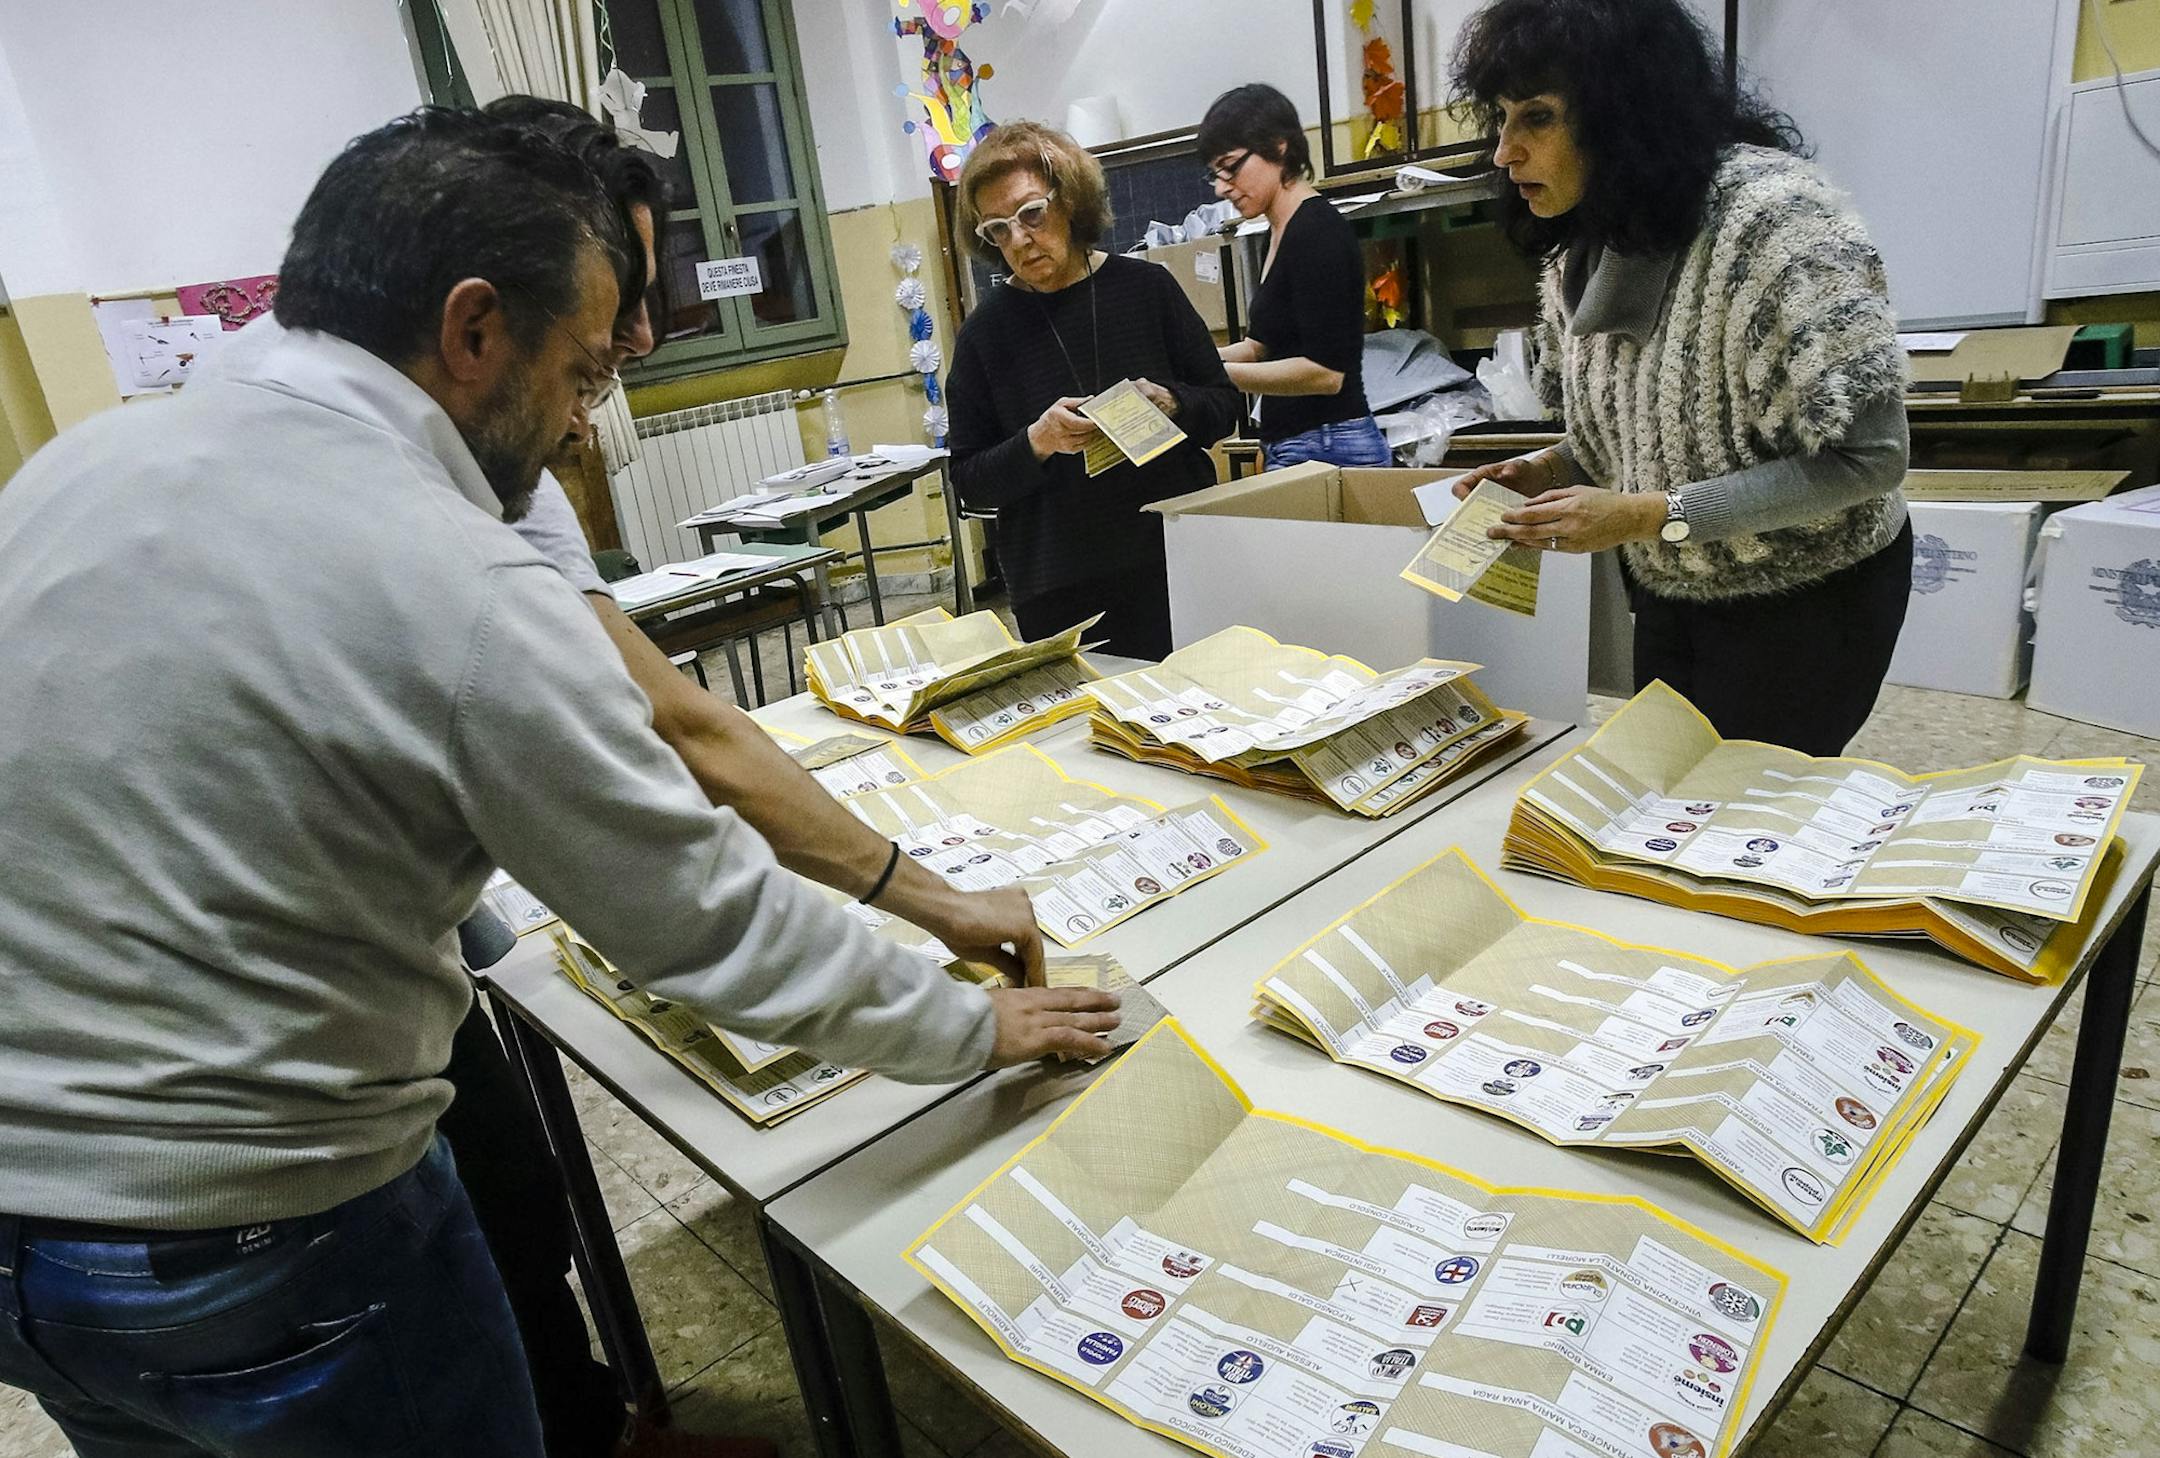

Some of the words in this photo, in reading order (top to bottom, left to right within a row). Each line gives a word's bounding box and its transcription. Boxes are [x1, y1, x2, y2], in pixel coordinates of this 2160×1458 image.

[1348, 1202, 1388, 1219] CONSOLO
[1388, 1215, 1425, 1233] CLAUDIO
[1065, 1218, 1101, 1253] CAPORALE
[1323, 1247, 1362, 1265] INTORCIA
[1361, 1259, 1386, 1274] LUIGI
[1544, 1250, 1587, 1263] MORELLI
[1027, 1261, 1050, 1282] LAURI
[1588, 1254, 1642, 1284] DONATELLA
[1047, 1281, 1071, 1306] LAURA
[1287, 1291, 1314, 1306] GALDI
[1641, 1279, 1702, 1317] VINCENZINA
[976, 1300, 1009, 1334] ADINOLFI
[1314, 1300, 1354, 1322] ALFONSO
[1543, 1311, 1584, 1336] PD
[1006, 1329, 1031, 1353] MARIO
[1084, 1336, 1119, 1356] FAMIGLIA
[1245, 1334, 1283, 1353] AUGELLO
[1079, 1346, 1106, 1360] POPOLO
[1284, 1349, 1322, 1371] ALESSIA
[1541, 1339, 1581, 1365] BONINO
[1580, 1356, 1613, 1384] EMMA
[1471, 1387, 1499, 1400] RAGA
[1500, 1392, 1530, 1406] ANNA
[1672, 1373, 1724, 1407] insieme
[1188, 1397, 1224, 1416] MELONI
[1343, 1402, 1377, 1415] SALVINI
[1530, 1402, 1567, 1424] MARIA
[1332, 1418, 1368, 1435] LEGA
[1214, 1436, 1256, 1458] EDERICO
[1566, 1419, 1632, 1458] FRANCESCA
